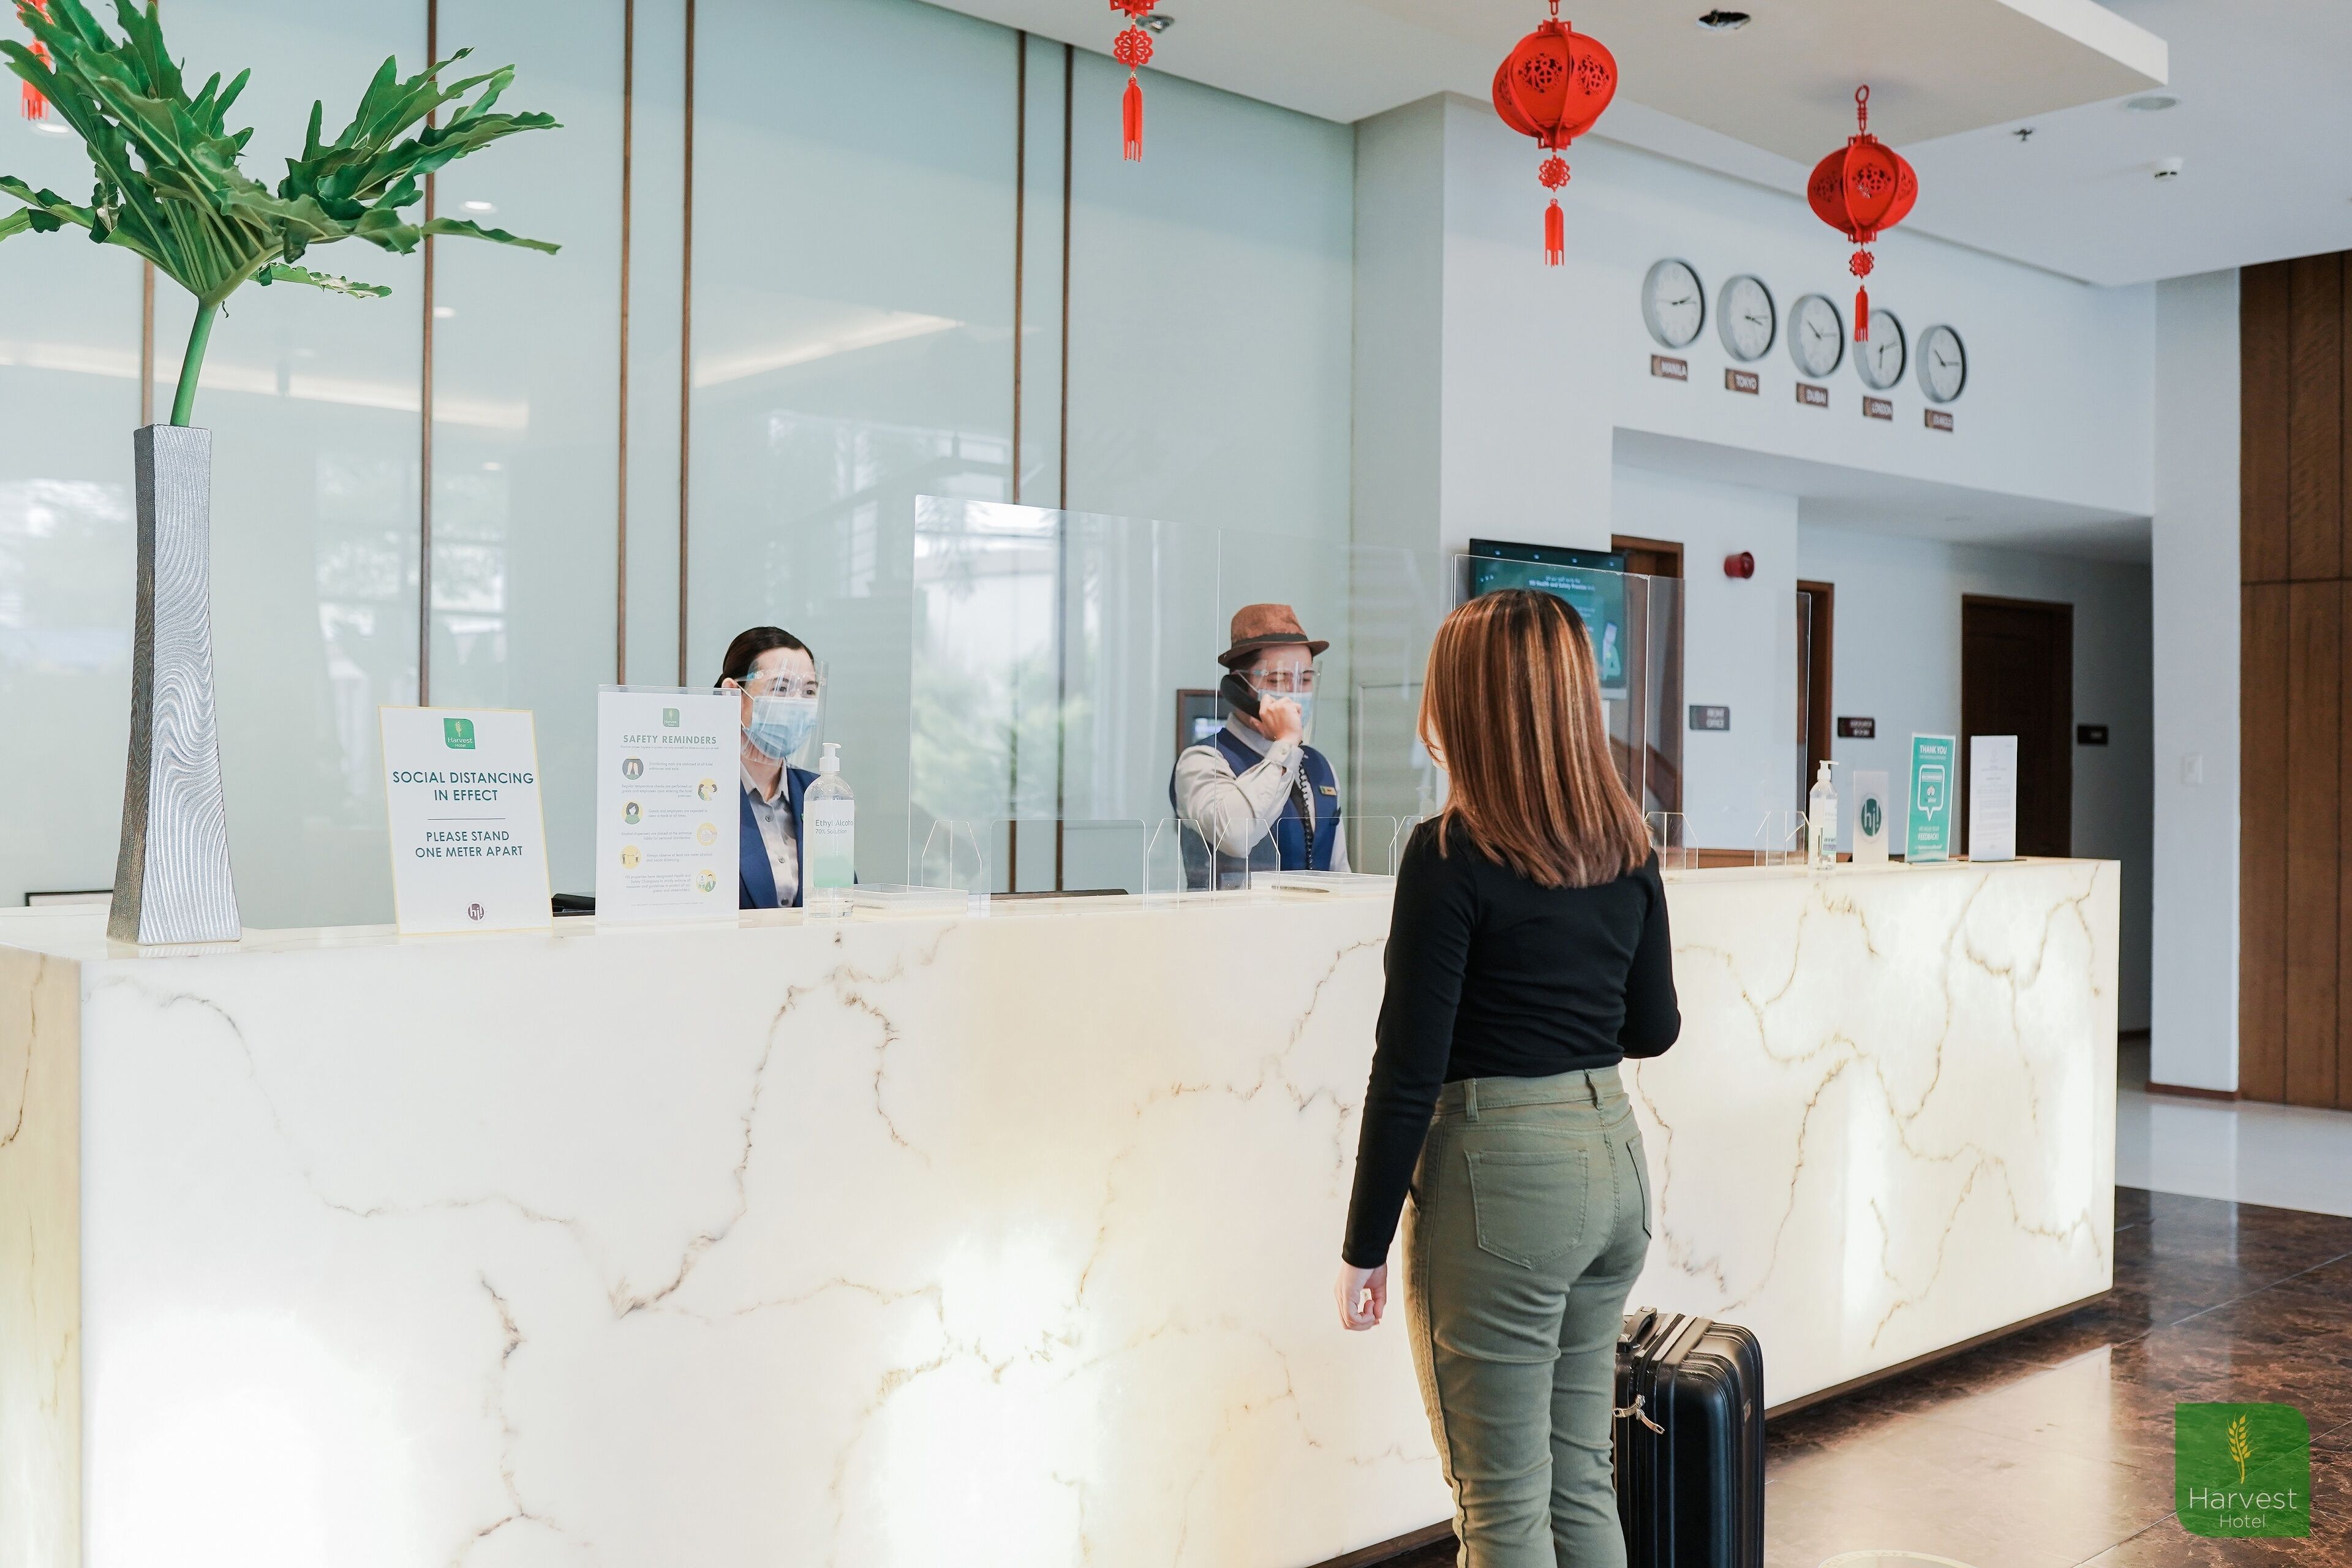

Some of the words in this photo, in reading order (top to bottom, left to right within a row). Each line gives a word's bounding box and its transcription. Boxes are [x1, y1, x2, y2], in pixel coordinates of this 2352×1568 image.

[623, 734, 658, 743] SAFETY
[662, 736, 717, 744] REMINDERS
[1920, 744, 1937, 754] THANK
[1937, 745, 1947, 755] YOU
[393, 771, 445, 783] SOCIAL
[450, 772, 533, 784] DISTANCING
[434, 790, 448, 801] IN
[453, 790, 497, 801] EFFECT
[426, 831, 467, 842] PLEASE
[472, 831, 509, 841] STAND
[415, 847, 442, 858] ONE
[446, 846, 482, 857] METER
[486, 846, 522, 856] APART
